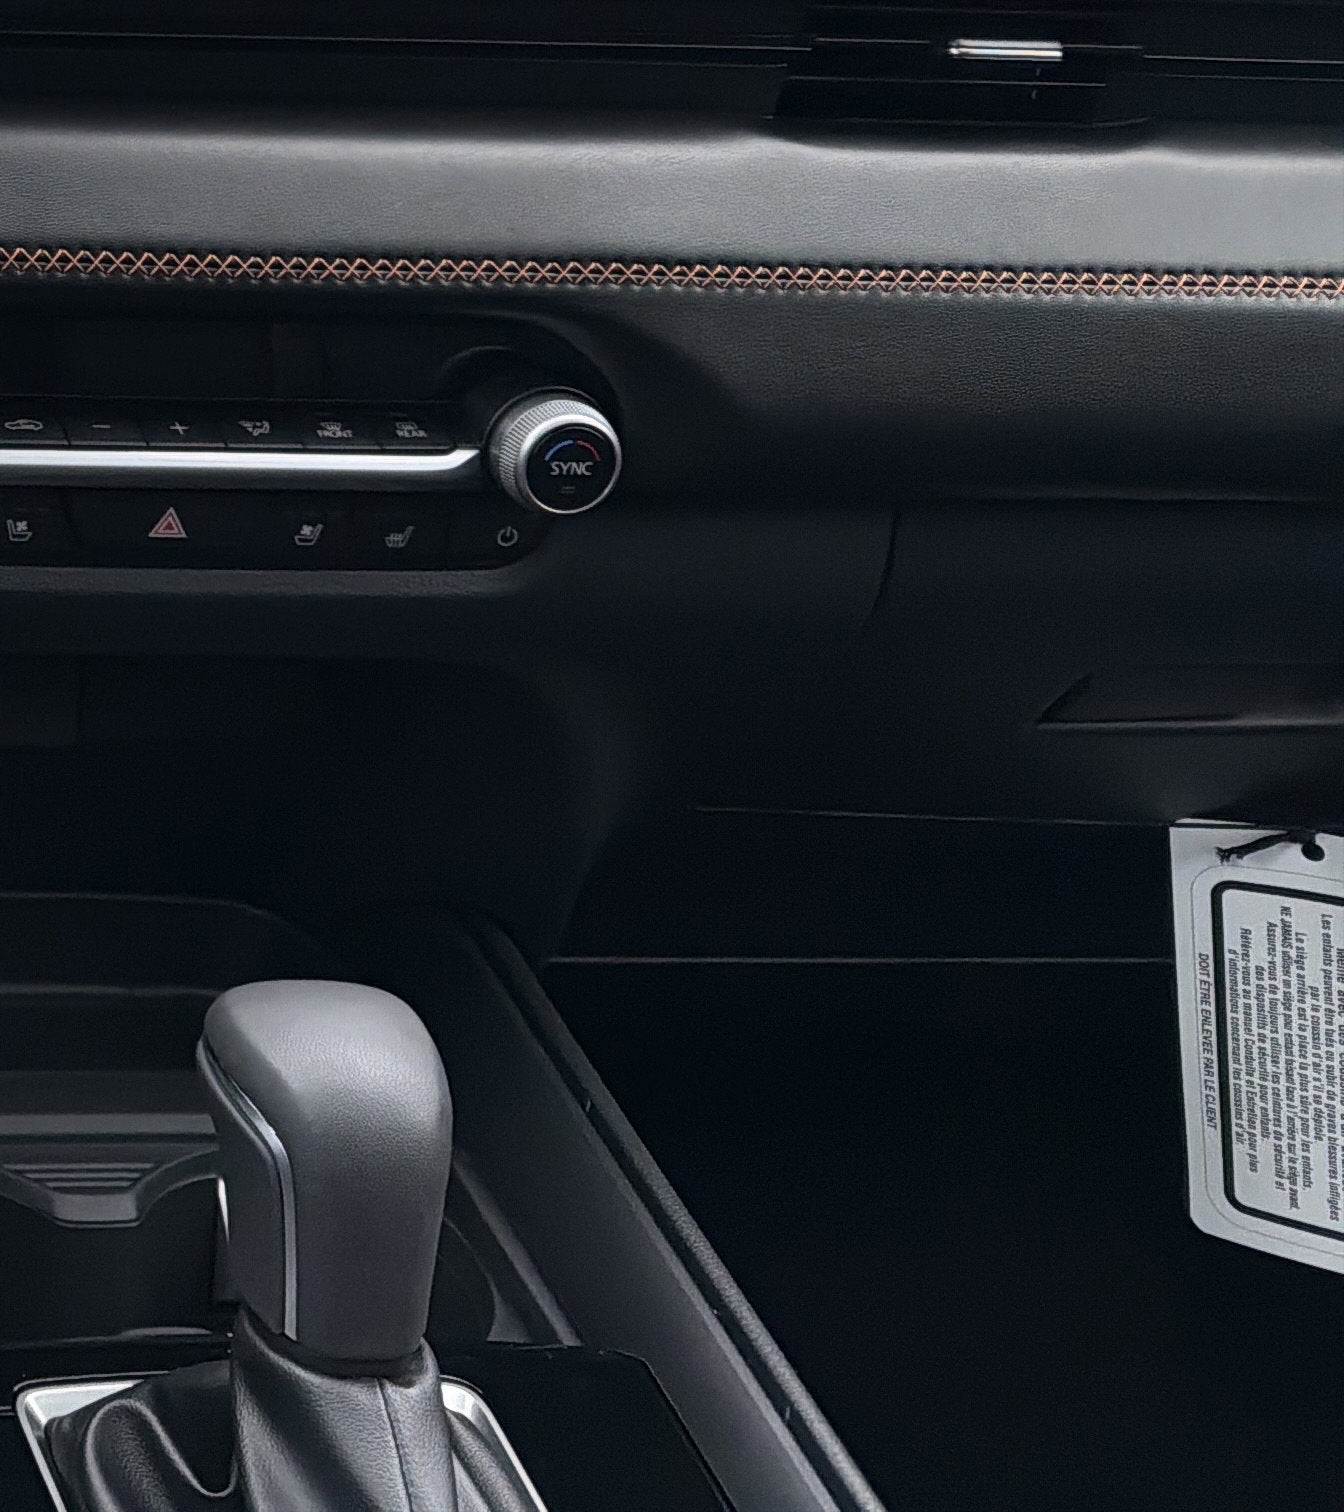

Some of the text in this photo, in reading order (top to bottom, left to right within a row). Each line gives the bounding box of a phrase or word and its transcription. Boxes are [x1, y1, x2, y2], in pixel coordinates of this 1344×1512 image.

[316, 428, 353, 439] FRONT
[395, 428, 427, 439] REAR
[549, 460, 594, 477] SYNC
[1281, 906, 1292, 919] NE
[1321, 914, 1333, 930] Les
[1295, 932, 1308, 943] Le
[1267, 921, 1278, 981] Assurez-vous
[1294, 946, 1308, 971] siège
[1322, 933, 1334, 967] enfants
[1199, 952, 1210, 978] DOIT
[1255, 965, 1266, 981] des
[1269, 984, 1280, 995] de
[1308, 986, 1320, 1002] par
[1321, 969, 1335, 1005] peuvent
[1268, 998, 1282, 1034] toujours
[1200, 1009, 1214, 1056] ENLEVEE
[1231, 1016, 1243, 1065] concernant
[1311, 1015, 1323, 1050] coussin
[1296, 1034, 1309, 1060] place
[1203, 1057, 1214, 1077] PAR
[1232, 1067, 1243, 1081] les
[1272, 1071, 1283, 1084] les
[1326, 1064, 1338, 1088] subir
[1204, 1079, 1215, 1092] LE
[1298, 1073, 1311, 1093] plus
[1257, 1083, 1268, 1105] pour
[1327, 1090, 1338, 1101] de
[1205, 1094, 1217, 1130] CLIENT
[1324, 1103, 1337, 1134] graves
[1299, 1117, 1311, 1138] pour
[1246, 1131, 1258, 1152] pour
[1246, 1153, 1259, 1173] plus
[1328, 1136, 1340, 1180] blessures
